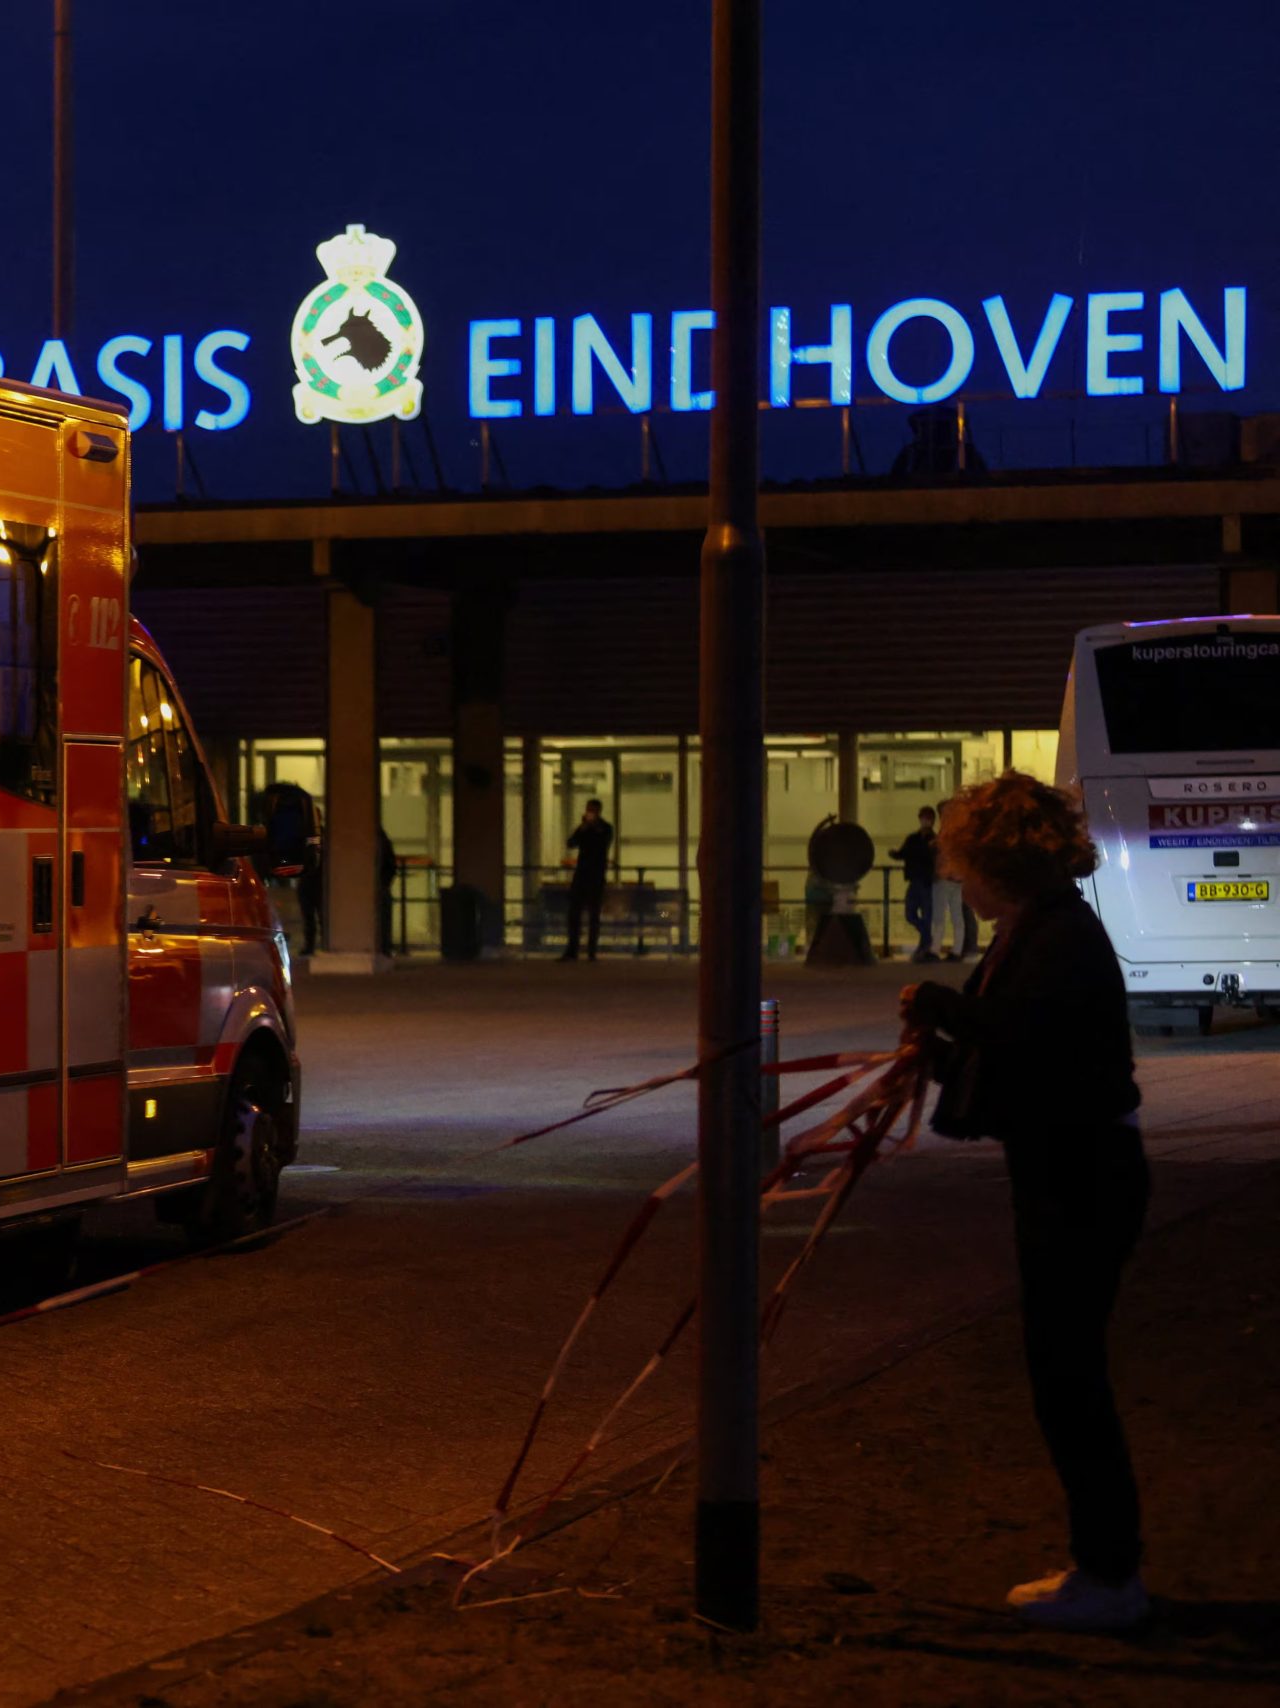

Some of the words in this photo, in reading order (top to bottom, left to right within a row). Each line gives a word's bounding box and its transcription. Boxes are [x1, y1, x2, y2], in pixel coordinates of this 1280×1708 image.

[468, 286, 1247, 418] EINDHOVEN
[88, 597, 120, 650] 112
[1184, 781, 1267, 792] ROSERO
